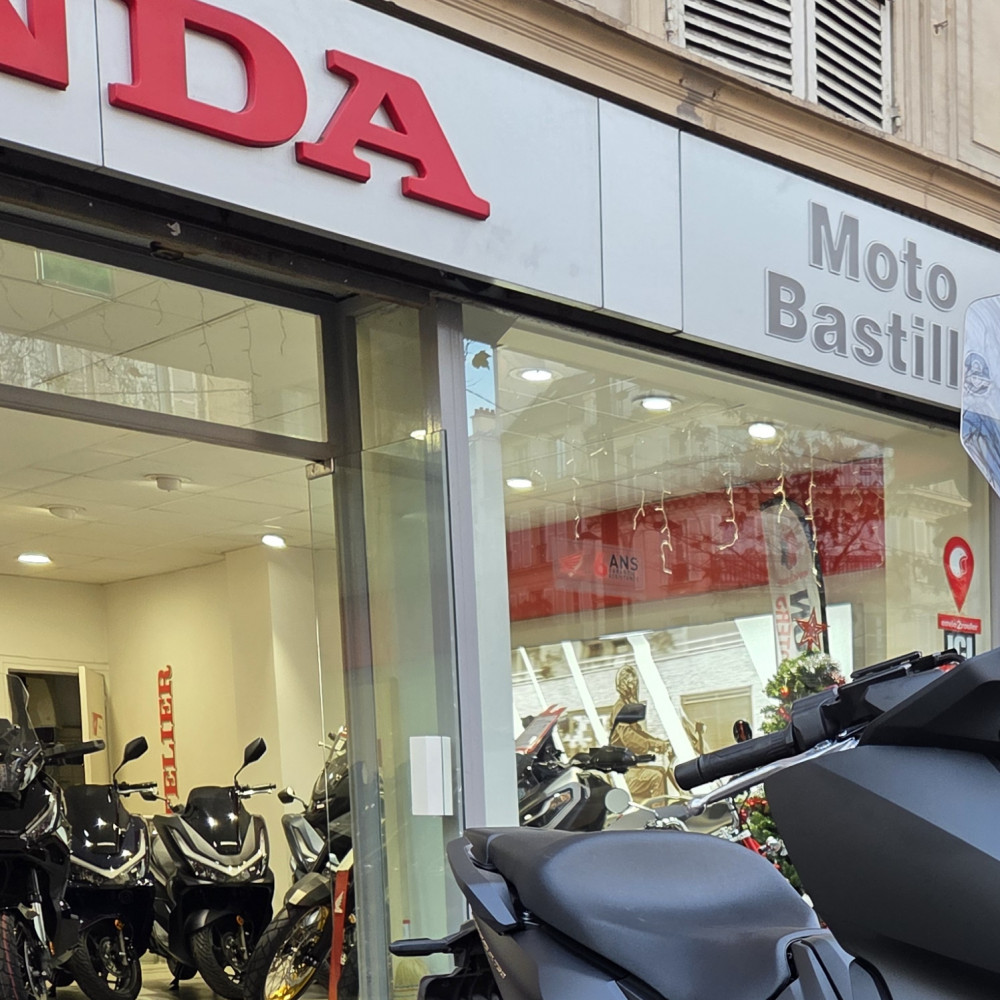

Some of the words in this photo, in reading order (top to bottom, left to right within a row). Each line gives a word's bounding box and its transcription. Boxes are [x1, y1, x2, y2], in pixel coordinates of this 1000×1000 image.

[808, 200, 958, 312] Moto
[764, 267, 961, 390] Bastill
[609, 554, 639, 571] ANS
[947, 634, 974, 660] ICI
